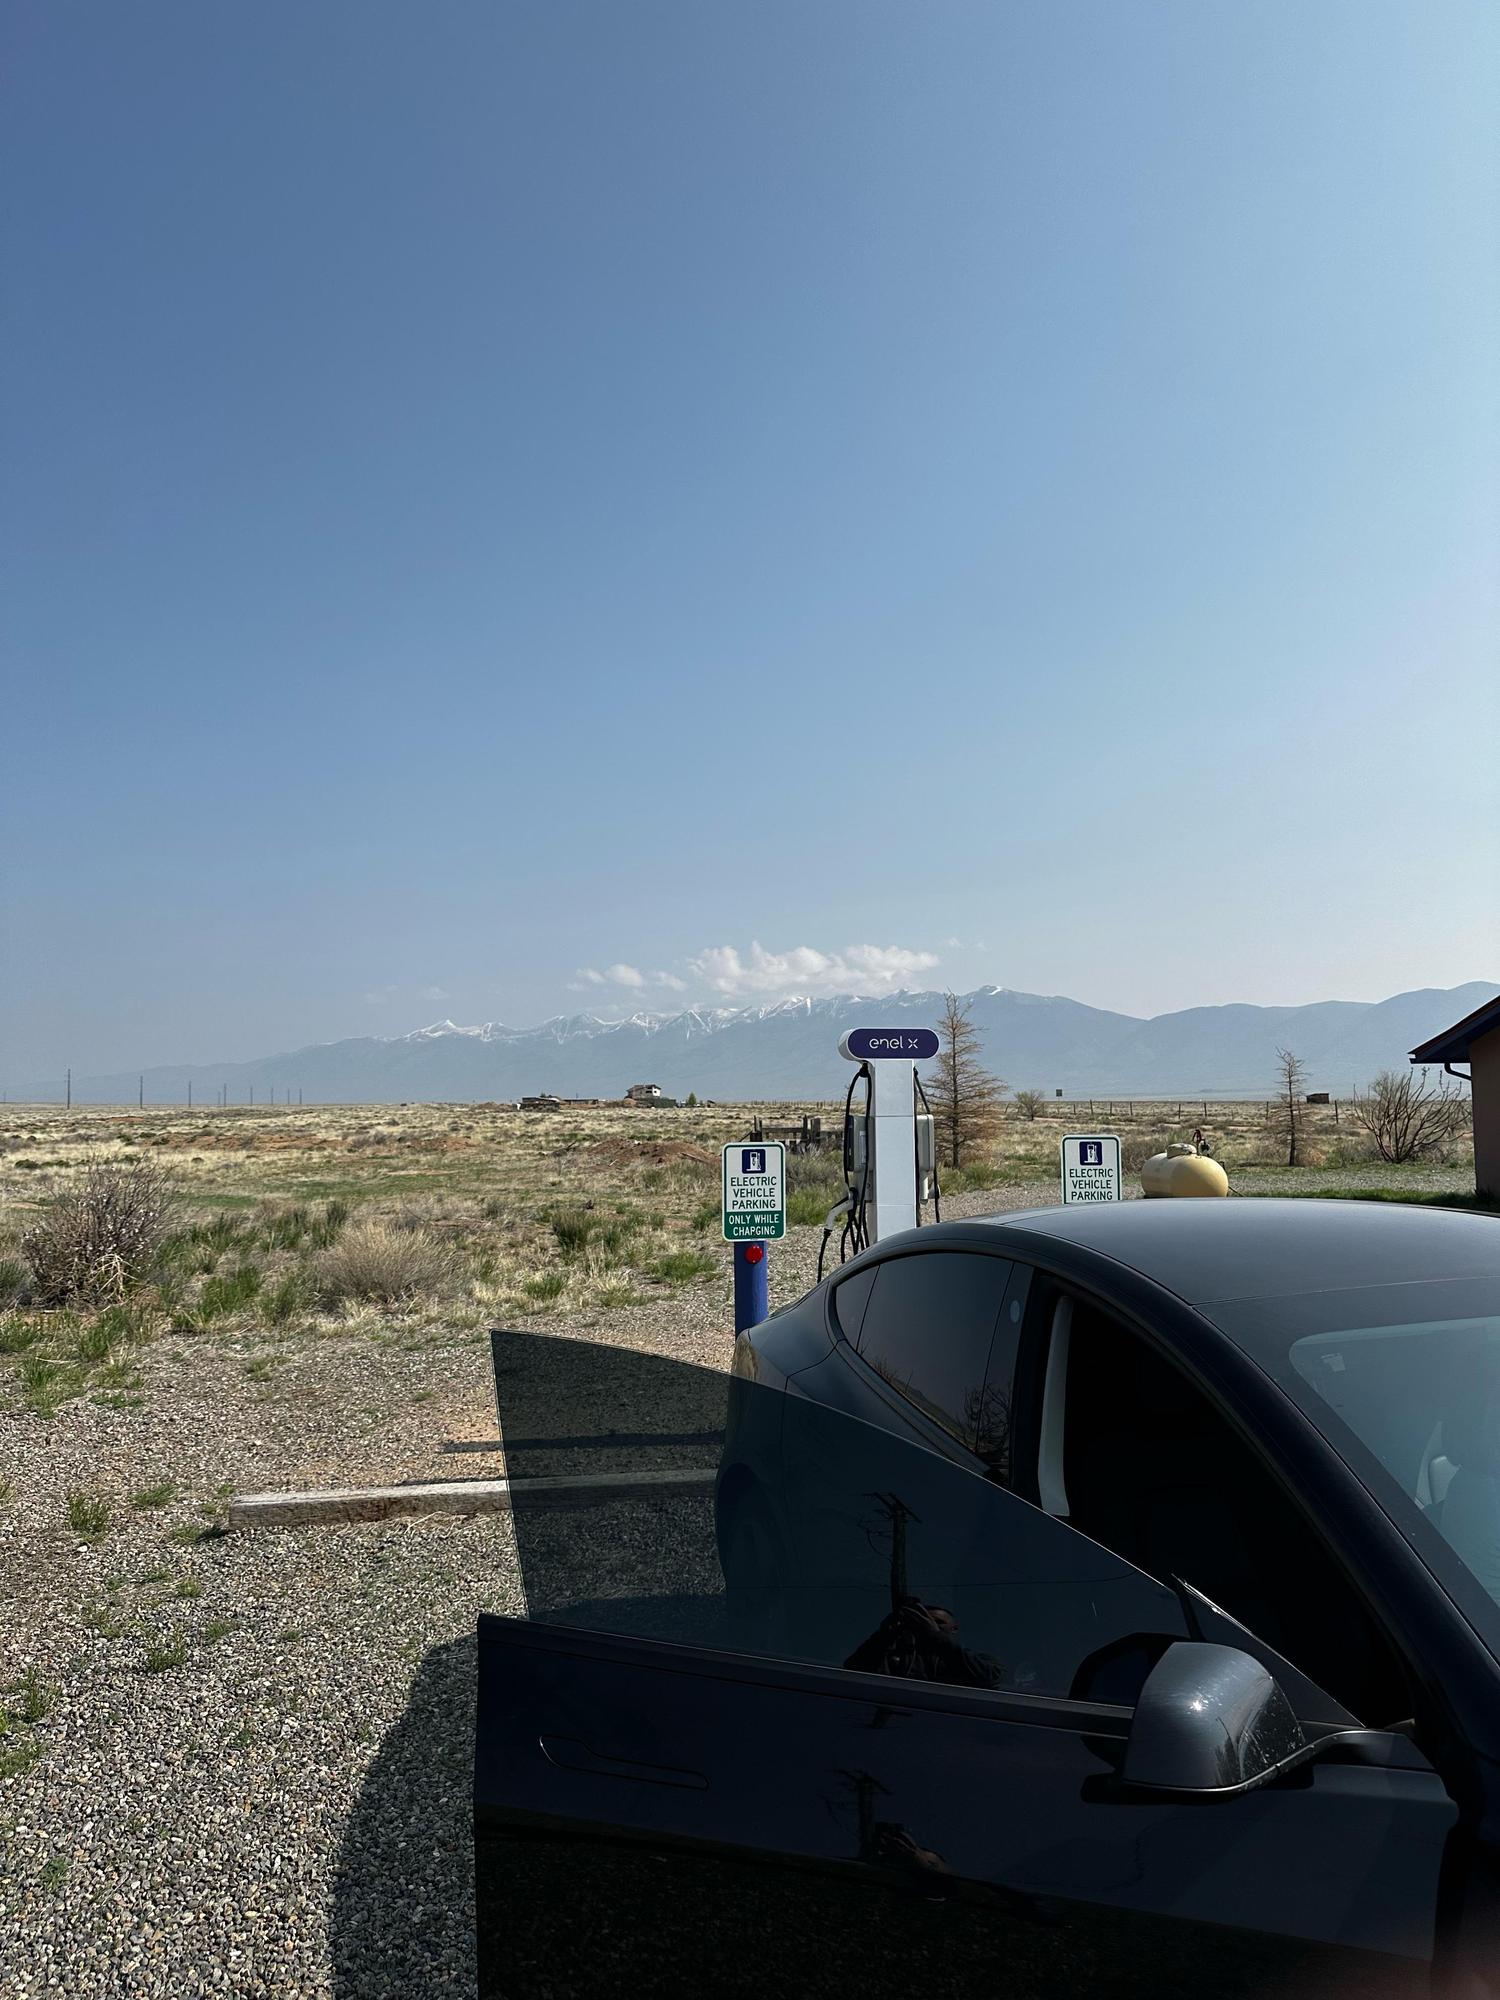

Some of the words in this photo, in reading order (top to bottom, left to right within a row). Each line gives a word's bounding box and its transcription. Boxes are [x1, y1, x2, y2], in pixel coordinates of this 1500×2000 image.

[869, 1035, 904, 1049] enel
[907, 1038, 918, 1049] x
[1069, 1168, 1114, 1178] ELECTRIC
[730, 1176, 777, 1187] ELECTRIC
[1071, 1179, 1112, 1189] VEHICLE
[733, 1188, 775, 1198] VEHICLE
[1071, 1190, 1113, 1201] PARKING
[732, 1199, 776, 1210] PARKING
[728, 1214, 751, 1225] ONLY
[754, 1213, 780, 1224] WHILE
[733, 1226, 776, 1236] CHARGING
